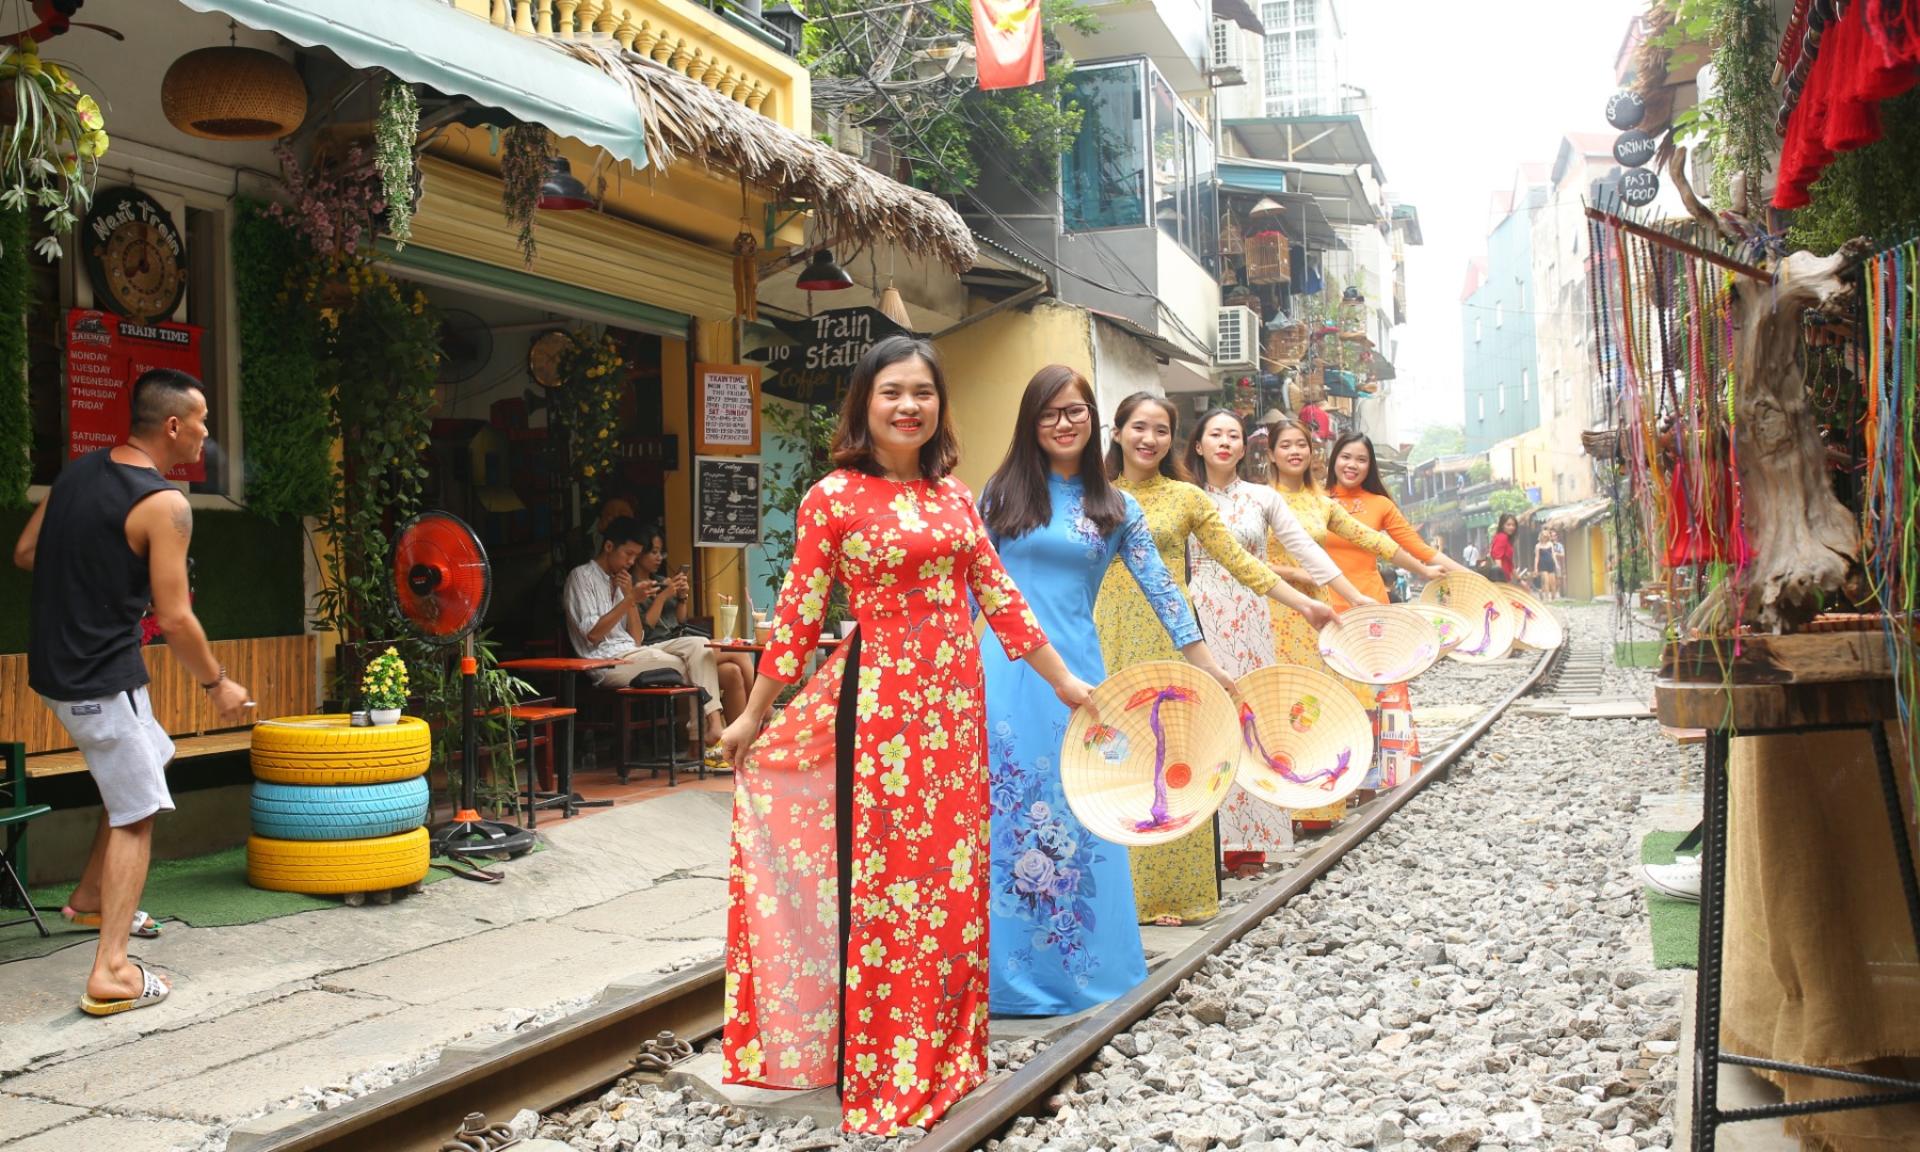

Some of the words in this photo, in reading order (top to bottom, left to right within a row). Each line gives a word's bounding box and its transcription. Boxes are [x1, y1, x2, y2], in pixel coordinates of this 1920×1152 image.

[1617, 138, 1656, 157] DRINKS
[1625, 173, 1651, 187] FAST
[1626, 187, 1656, 200] FOOD
[92, 200, 135, 241] Next
[136, 200, 180, 256] Train
[119, 323, 157, 339] TRAIN
[159, 328, 189, 343] TIME
[811, 310, 874, 343] Train
[71, 350, 108, 362] MONDAY
[768, 345, 790, 361] 110
[71, 363, 111, 375] TUESDAY
[71, 375, 124, 388] WEDNESDAY
[72, 387, 117, 400] THURSDAY
[71, 400, 104, 411] FRIDAY
[72, 431, 117, 443] SATURDAY
[702, 524, 724, 535] Train
[727, 524, 757, 536] Station
